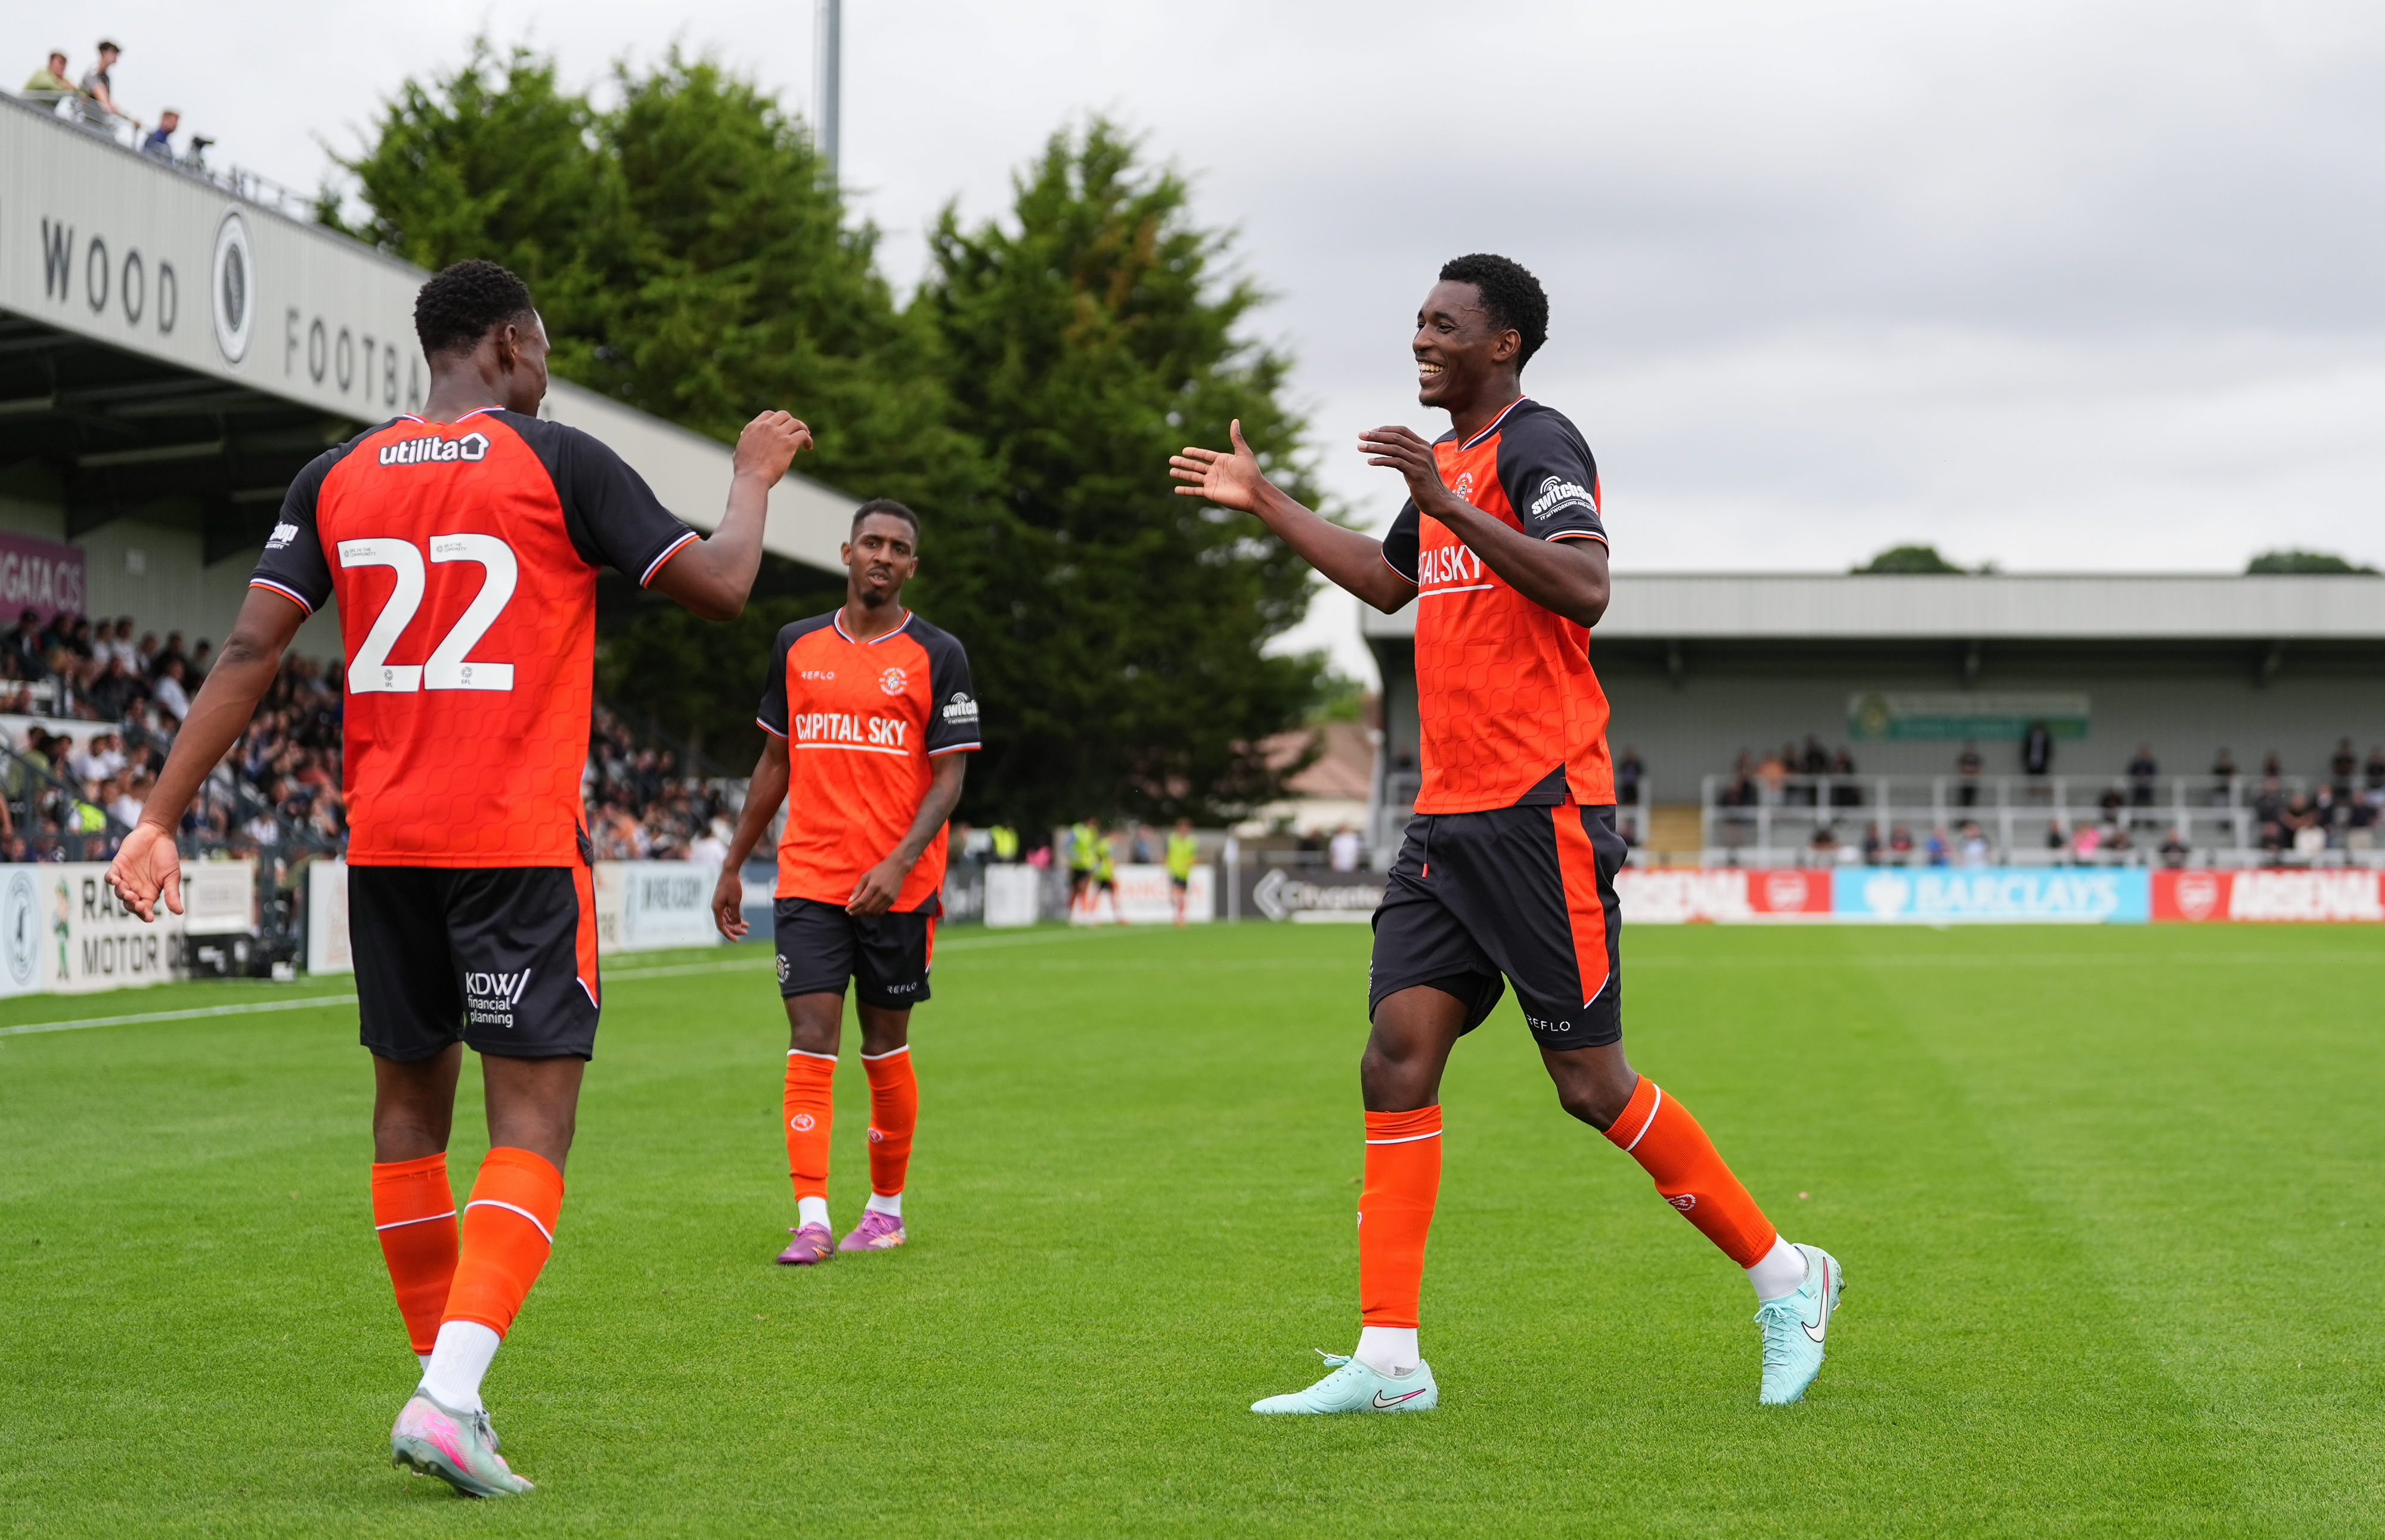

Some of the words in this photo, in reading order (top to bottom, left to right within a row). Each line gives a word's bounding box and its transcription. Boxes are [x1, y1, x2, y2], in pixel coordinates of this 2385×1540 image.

[41, 215, 177, 334] WOOD
[284, 304, 420, 413] FOOTBA
[379, 436, 459, 464] utilita
[1546, 501, 1577, 518] NETWORKING
[1440, 544, 1480, 582] SKY
[337, 532, 518, 695] 22
[801, 670, 834, 680] REFLO
[896, 667, 906, 678] TOWN
[795, 713, 863, 741] CAPITAL
[868, 717, 907, 746] SKY
[1613, 870, 1752, 919] RSENAL
[1916, 874, 2118, 912] BARCLAYS
[2228, 870, 2385, 920] ARSENAL
[82, 934, 157, 975] MOTOR
[468, 994, 511, 1010] financial
[887, 981, 916, 994] REFLO
[470, 1009, 513, 1028] planning
[1526, 1014, 1571, 1031] REFLO
